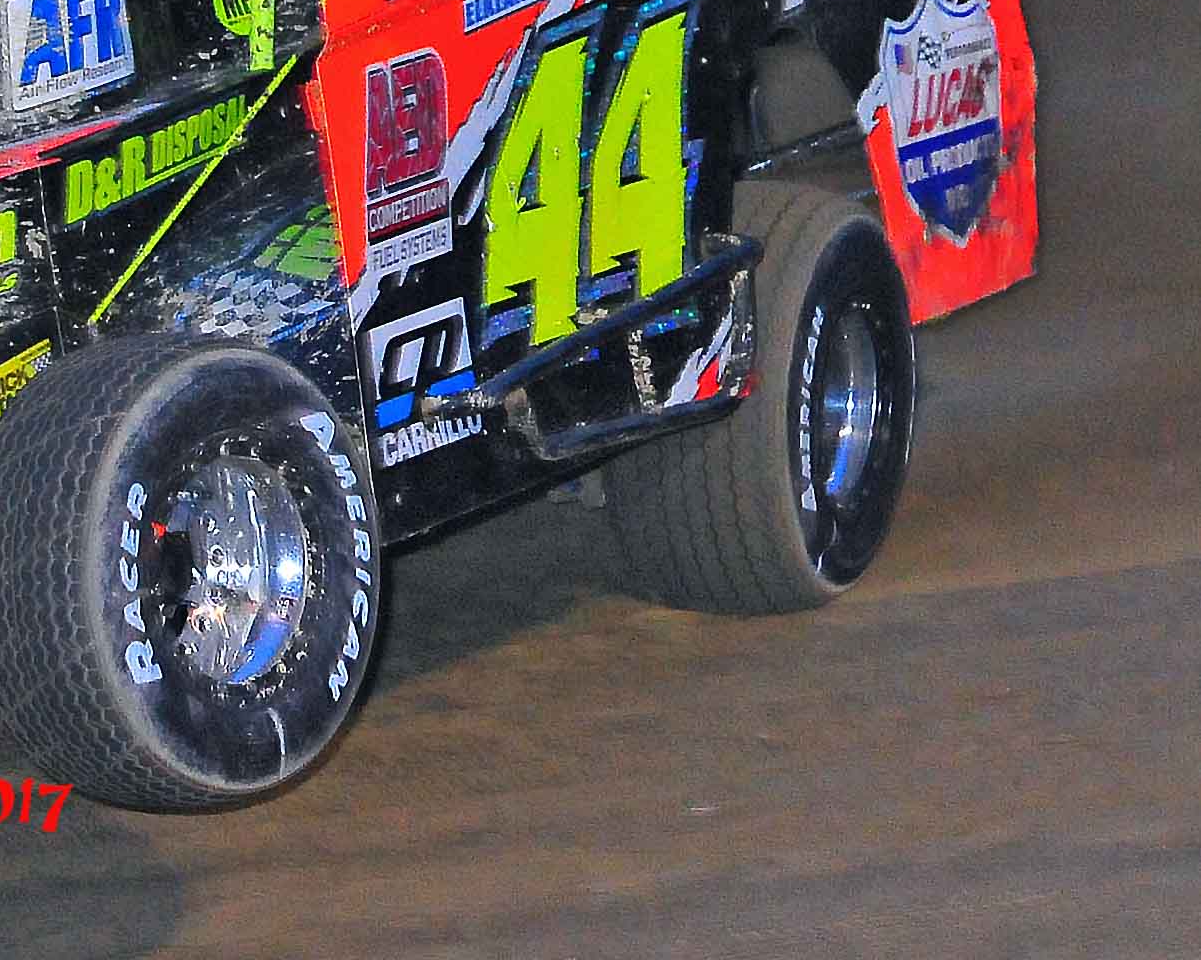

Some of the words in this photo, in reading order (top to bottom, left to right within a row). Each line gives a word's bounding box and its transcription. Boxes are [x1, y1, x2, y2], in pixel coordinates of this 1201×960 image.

[46, 74, 79, 94] Flow
[66, 135, 147, 225] D&R
[485, 10, 688, 347] 44
[119, 481, 163, 685] RACER
[299, 411, 372, 703] AMERICAN
